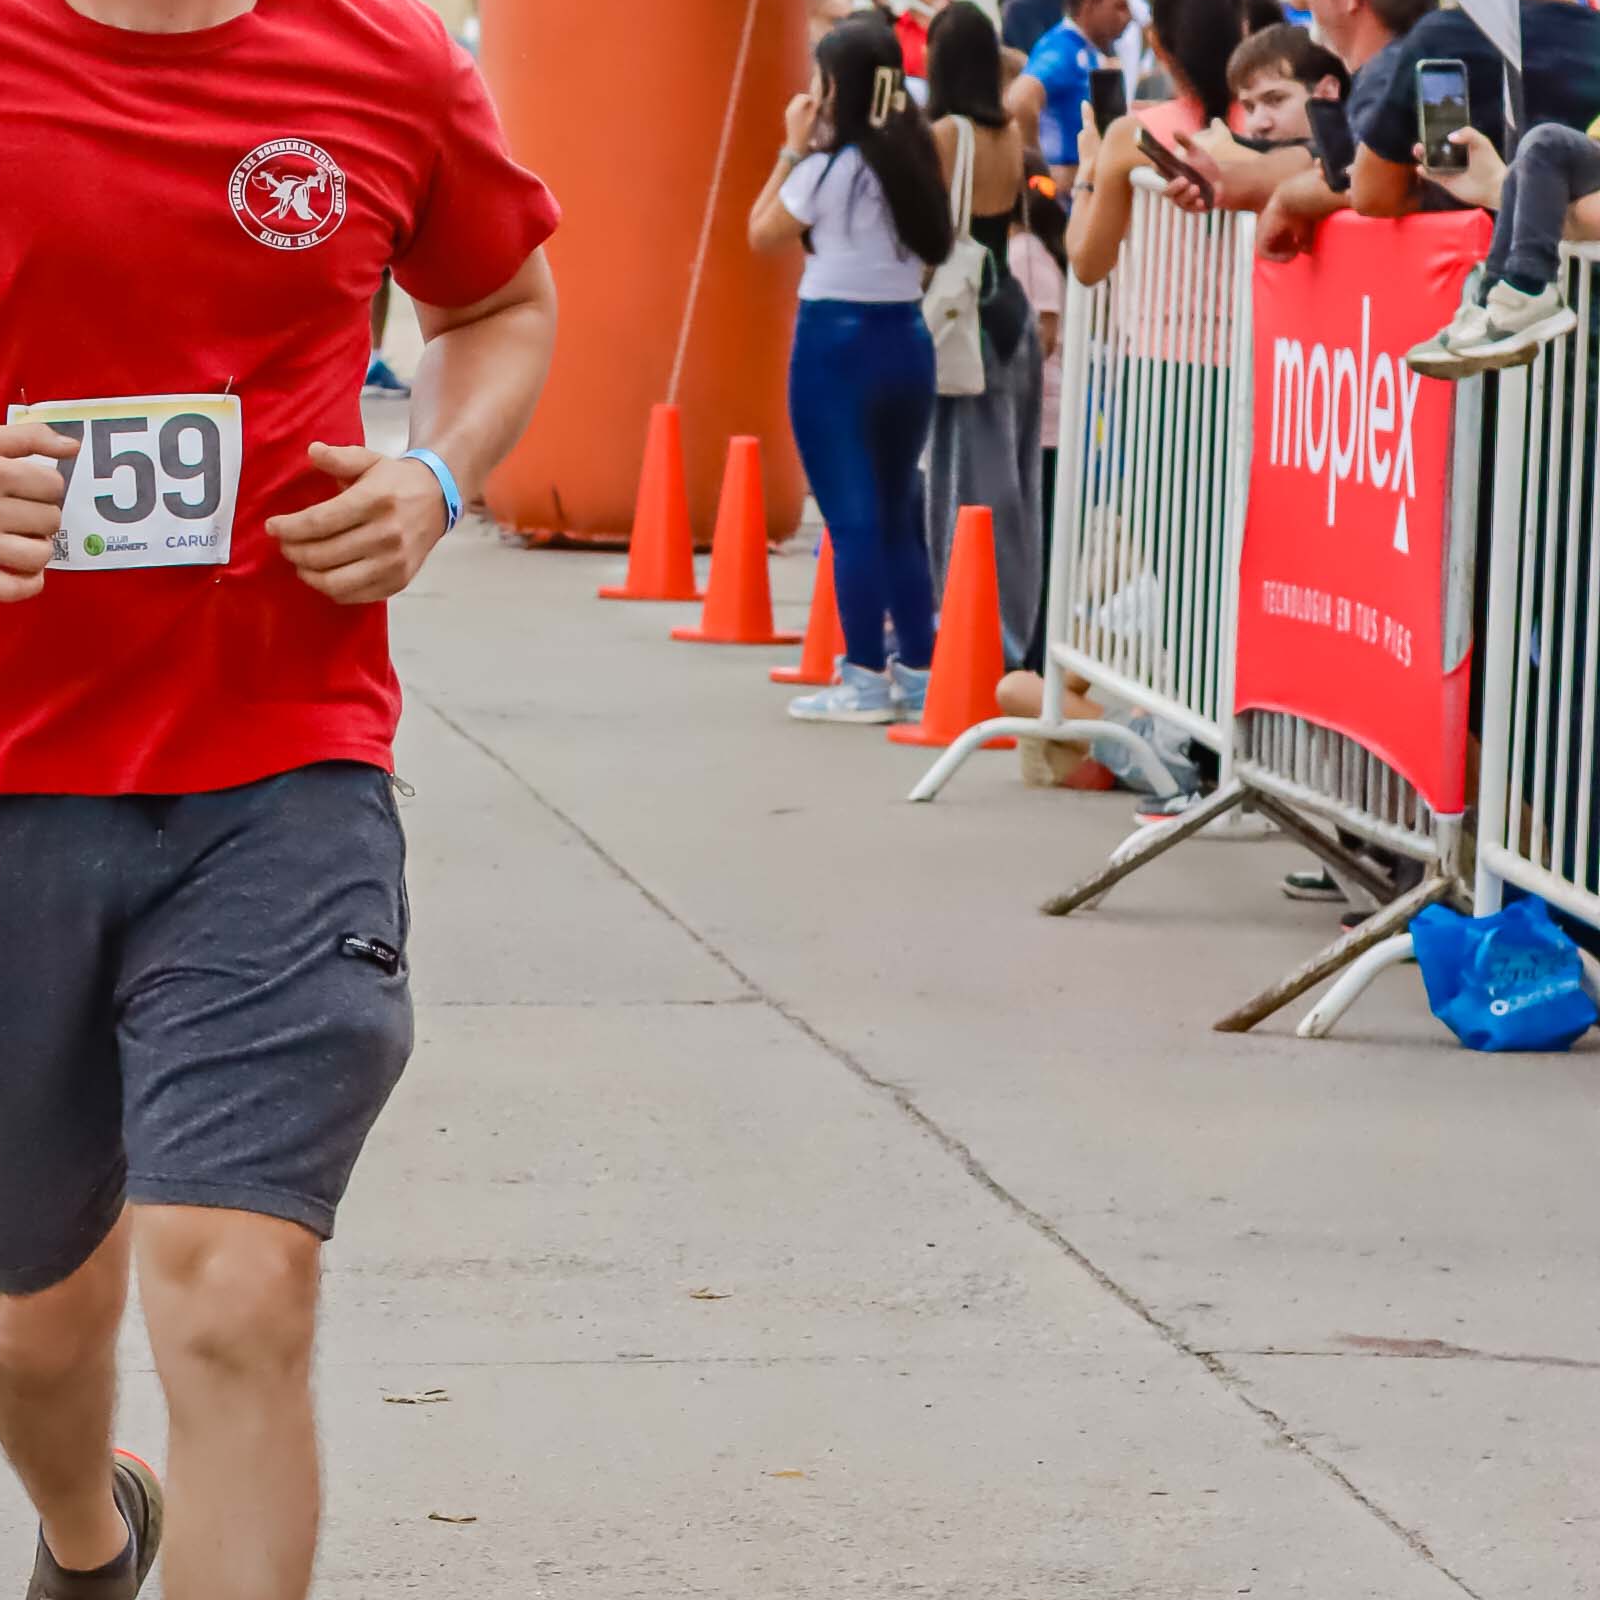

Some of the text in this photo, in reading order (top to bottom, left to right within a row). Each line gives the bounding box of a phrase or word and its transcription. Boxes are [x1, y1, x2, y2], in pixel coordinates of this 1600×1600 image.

[242, 156, 257, 171] DE
[259, 230, 292, 247] OLIVA
[1270, 295, 1421, 527] moplex
[1336, 595, 1351, 632] EN
[1355, 602, 1378, 645] TUS
[1383, 615, 1413, 668] PIES
